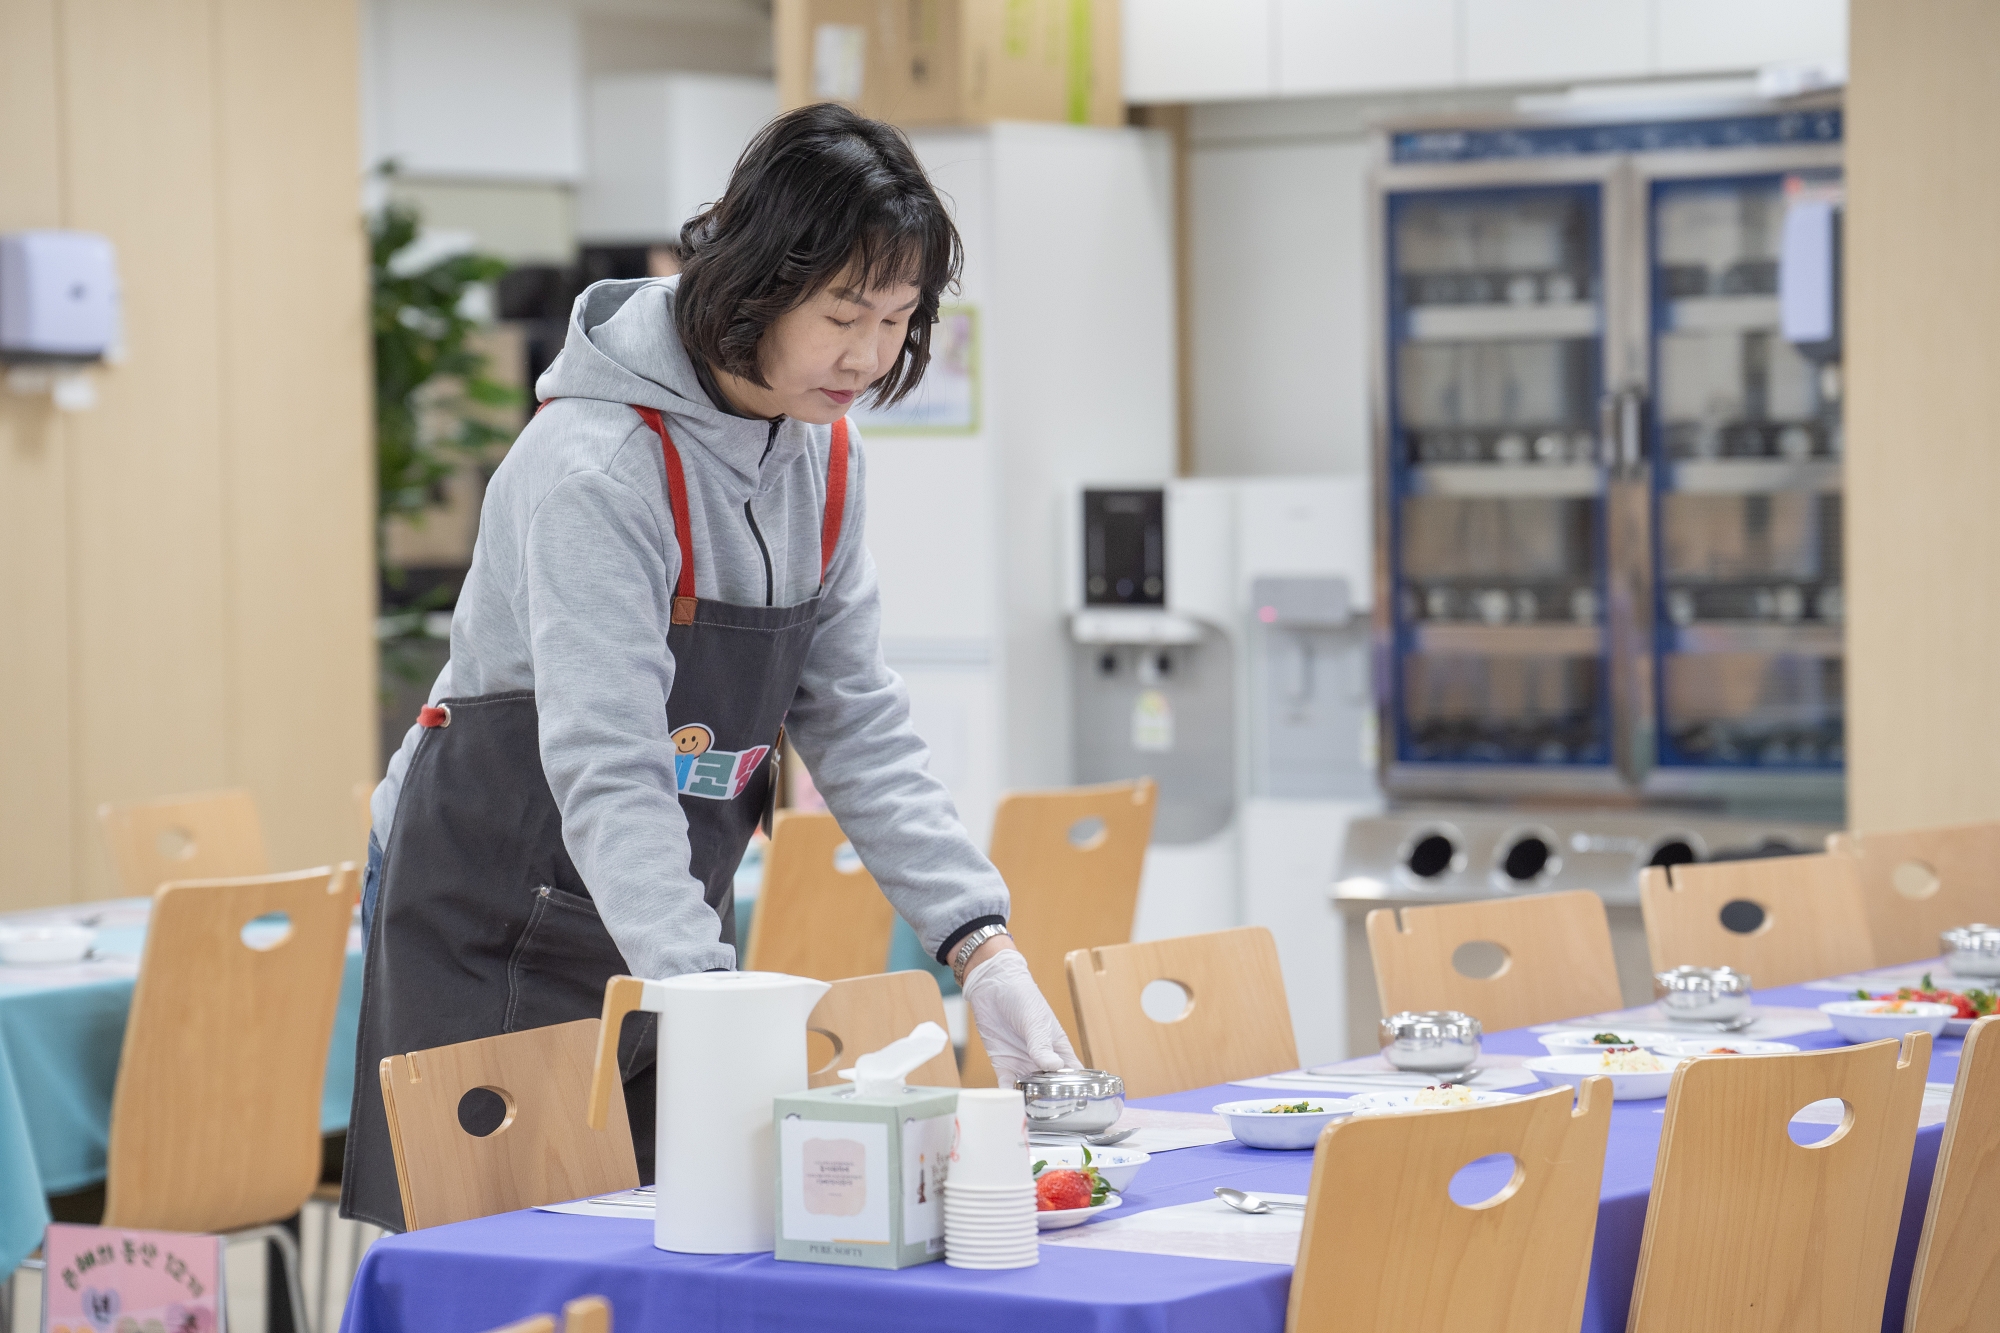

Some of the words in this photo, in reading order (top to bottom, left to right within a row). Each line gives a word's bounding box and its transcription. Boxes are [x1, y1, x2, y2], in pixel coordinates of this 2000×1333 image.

[675, 747, 768, 798] 코팀
[61, 1242, 116, 1291] 은혜의
[122, 1238, 159, 1268] 동산
[808, 1244, 832, 1255] PURE
[834, 1246, 863, 1258] SOFTY
